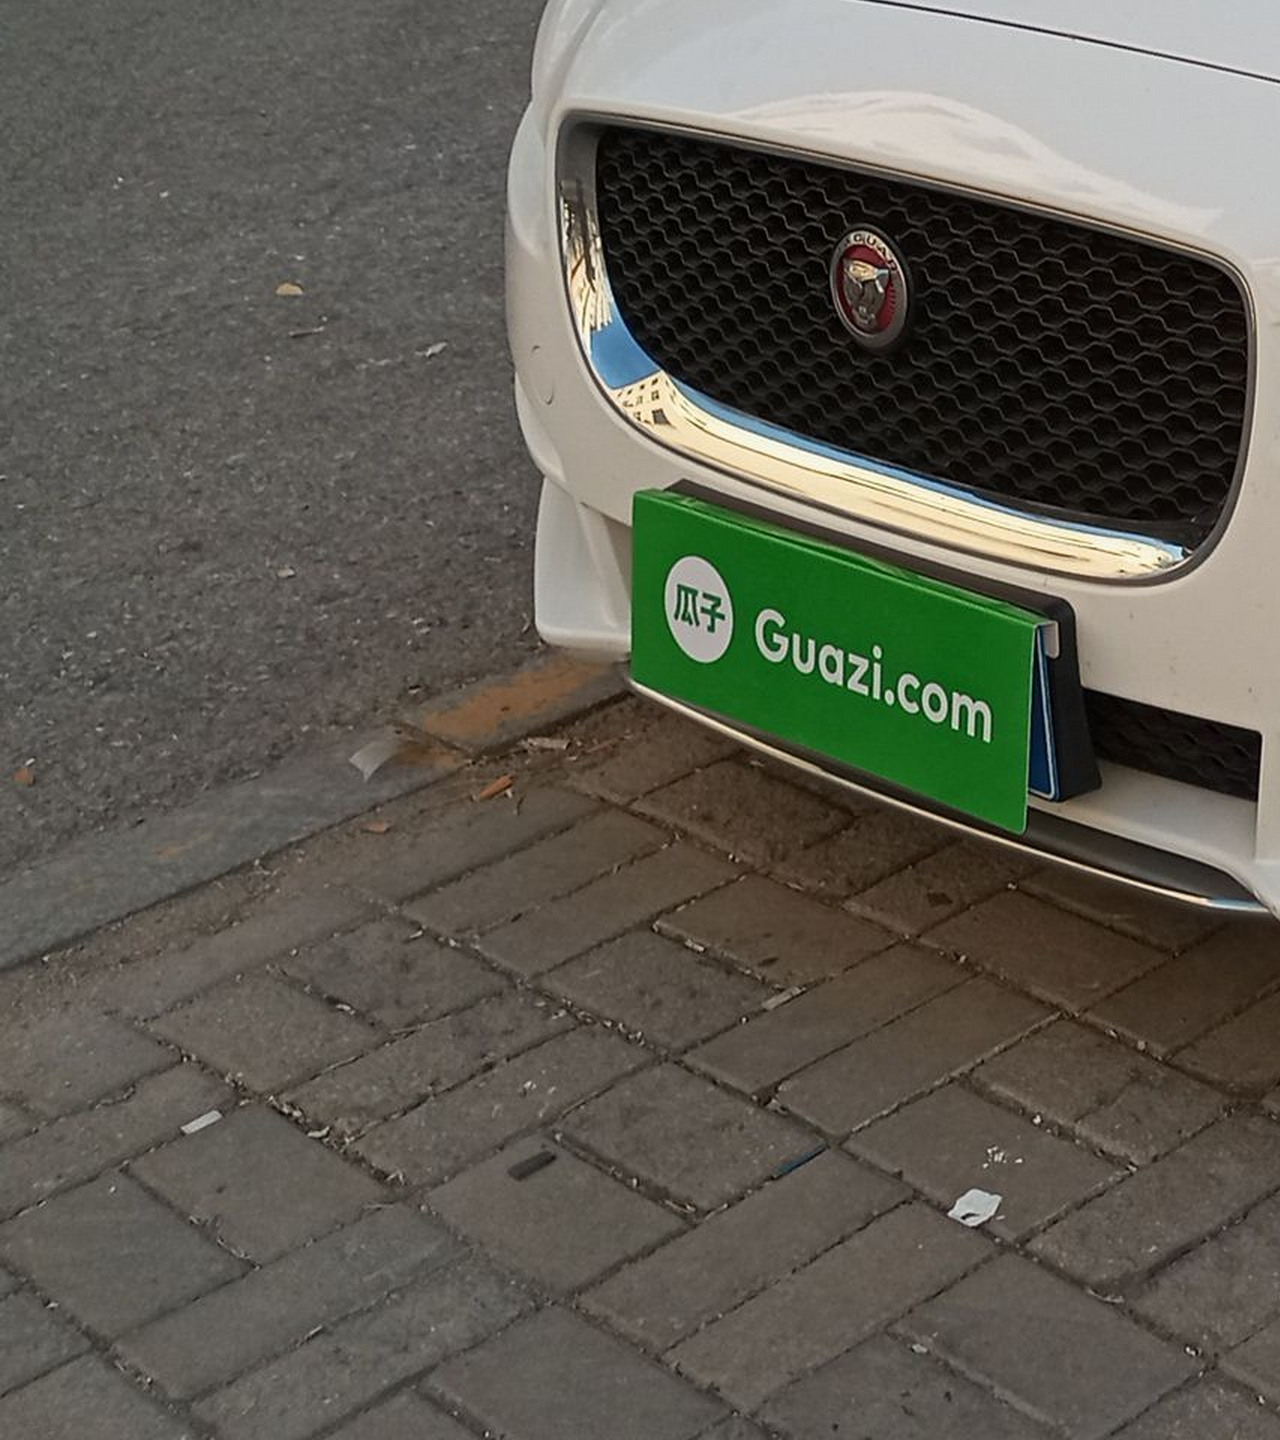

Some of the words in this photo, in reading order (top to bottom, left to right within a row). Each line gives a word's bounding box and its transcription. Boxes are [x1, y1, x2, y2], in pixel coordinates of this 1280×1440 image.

[838, 233, 897, 271] GUAR
[673, 582, 727, 634] 瓜子
[754, 608, 993, 744] Guazi.com
